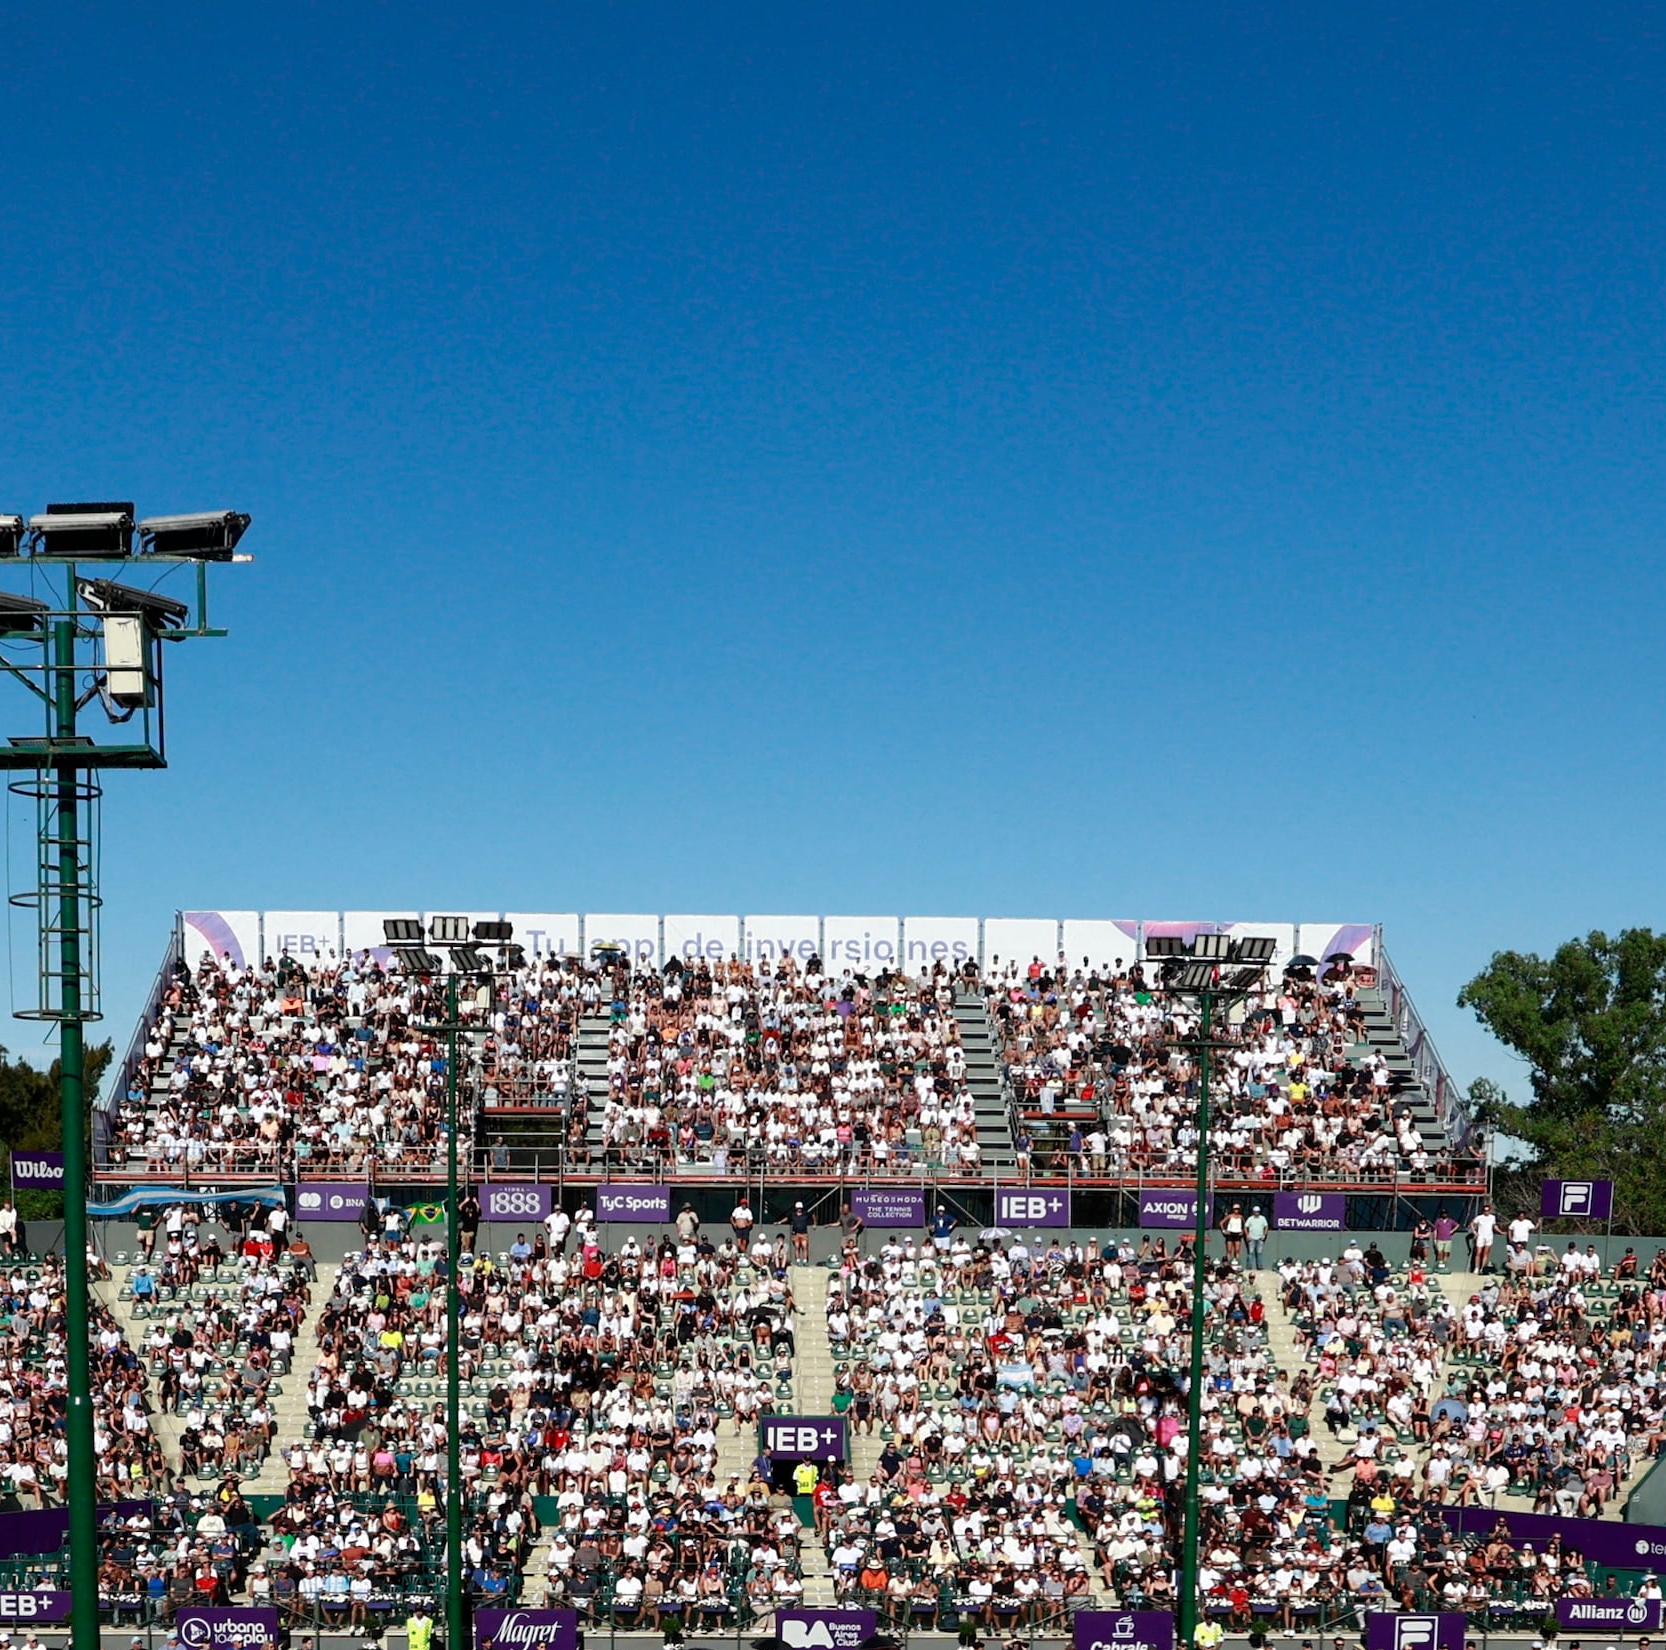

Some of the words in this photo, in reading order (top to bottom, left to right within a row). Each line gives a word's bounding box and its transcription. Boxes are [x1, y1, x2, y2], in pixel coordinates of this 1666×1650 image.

[277, 934, 330, 953] IEB+
[526, 930, 564, 957] Tu
[682, 932, 724, 960] de
[14, 1160, 64, 1178] Wilso
[345, 1198, 365, 1207] BNA
[489, 1192, 541, 1214] 1888
[600, 1195, 624, 1212] TyC
[625, 1195, 667, 1212] Sports
[1002, 1196, 1063, 1219] IEB+
[1143, 1202, 1188, 1214] AXION
[1278, 1218, 1340, 1228] BETWARRIOR
[767, 1426, 837, 1452] IEB+
[1569, 1603, 1624, 1620] Allianz
[213, 1617, 265, 1634] urbana
[828, 1622, 861, 1631] Buenos
[834, 1631, 858, 1639] Aires
